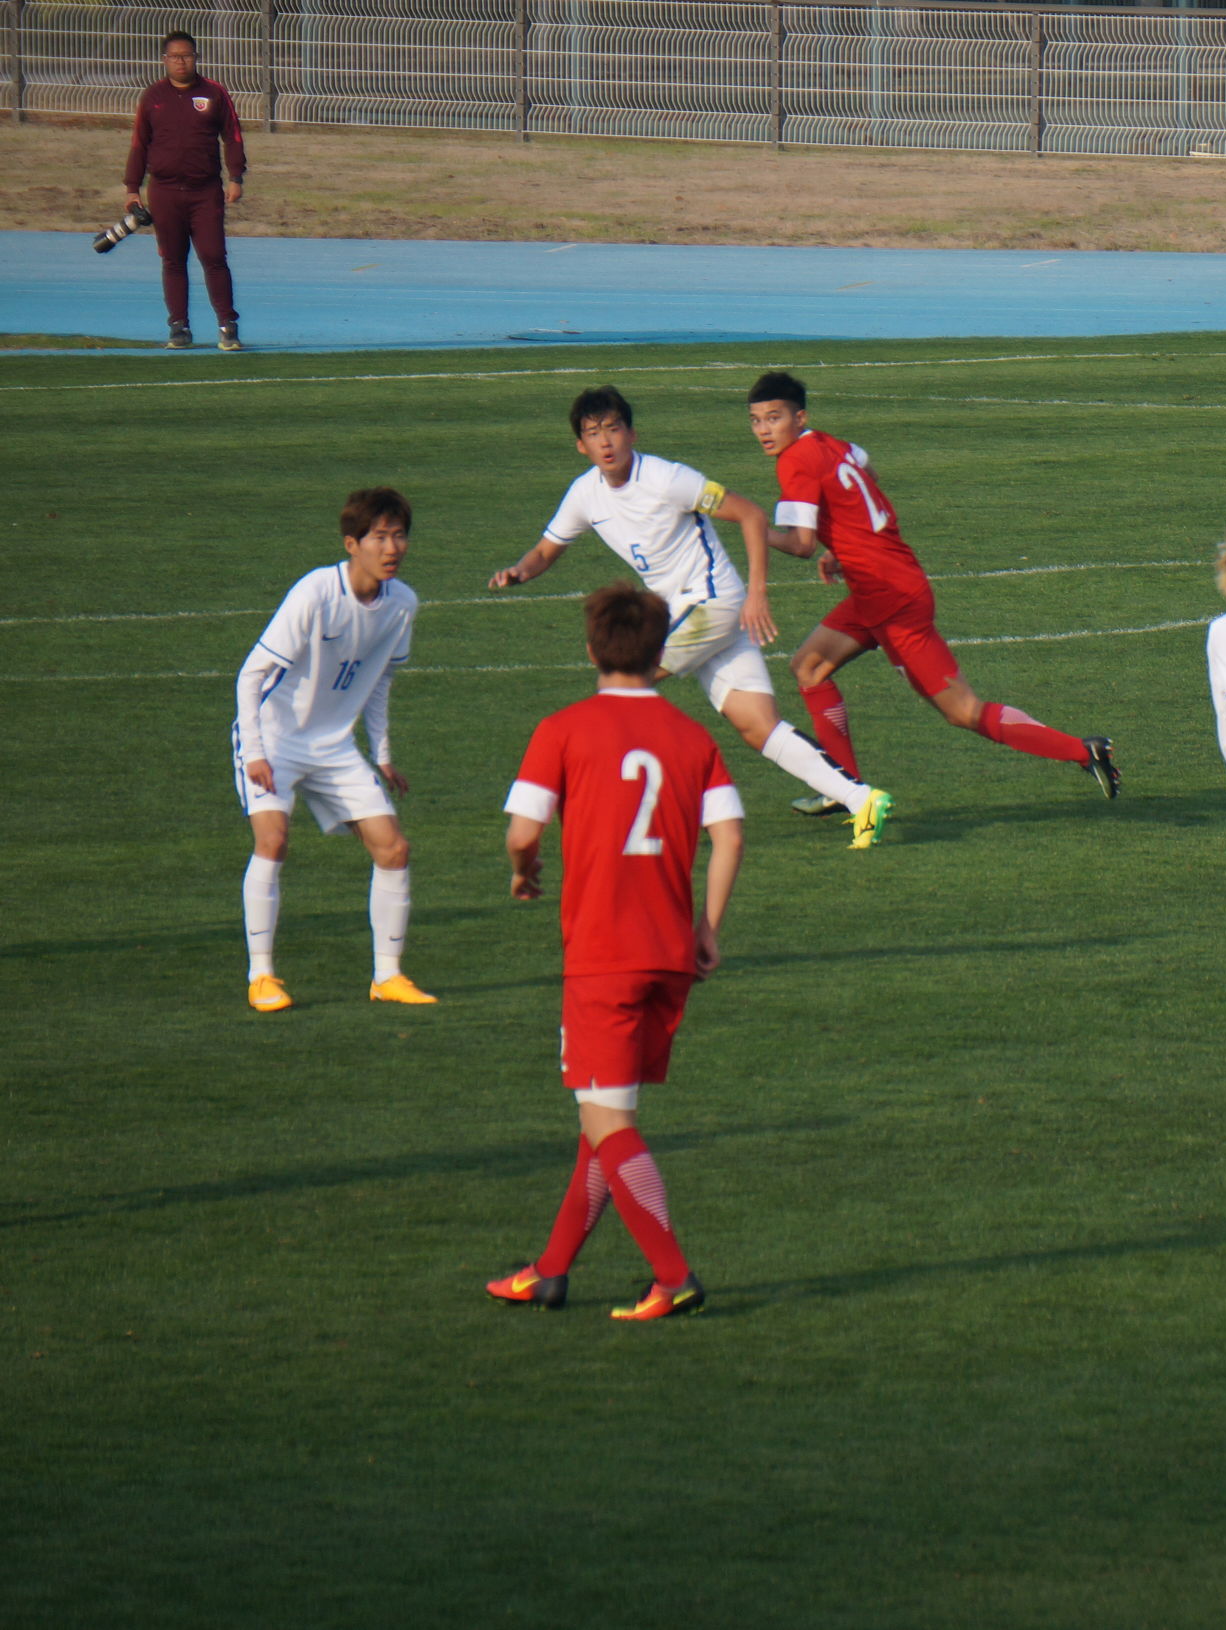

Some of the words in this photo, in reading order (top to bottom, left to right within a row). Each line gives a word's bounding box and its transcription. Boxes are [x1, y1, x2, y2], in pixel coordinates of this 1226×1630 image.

[838, 452, 890, 533] 2
[630, 544, 649, 572] 5
[331, 660, 361, 690] 16
[621, 749, 664, 856] 2
